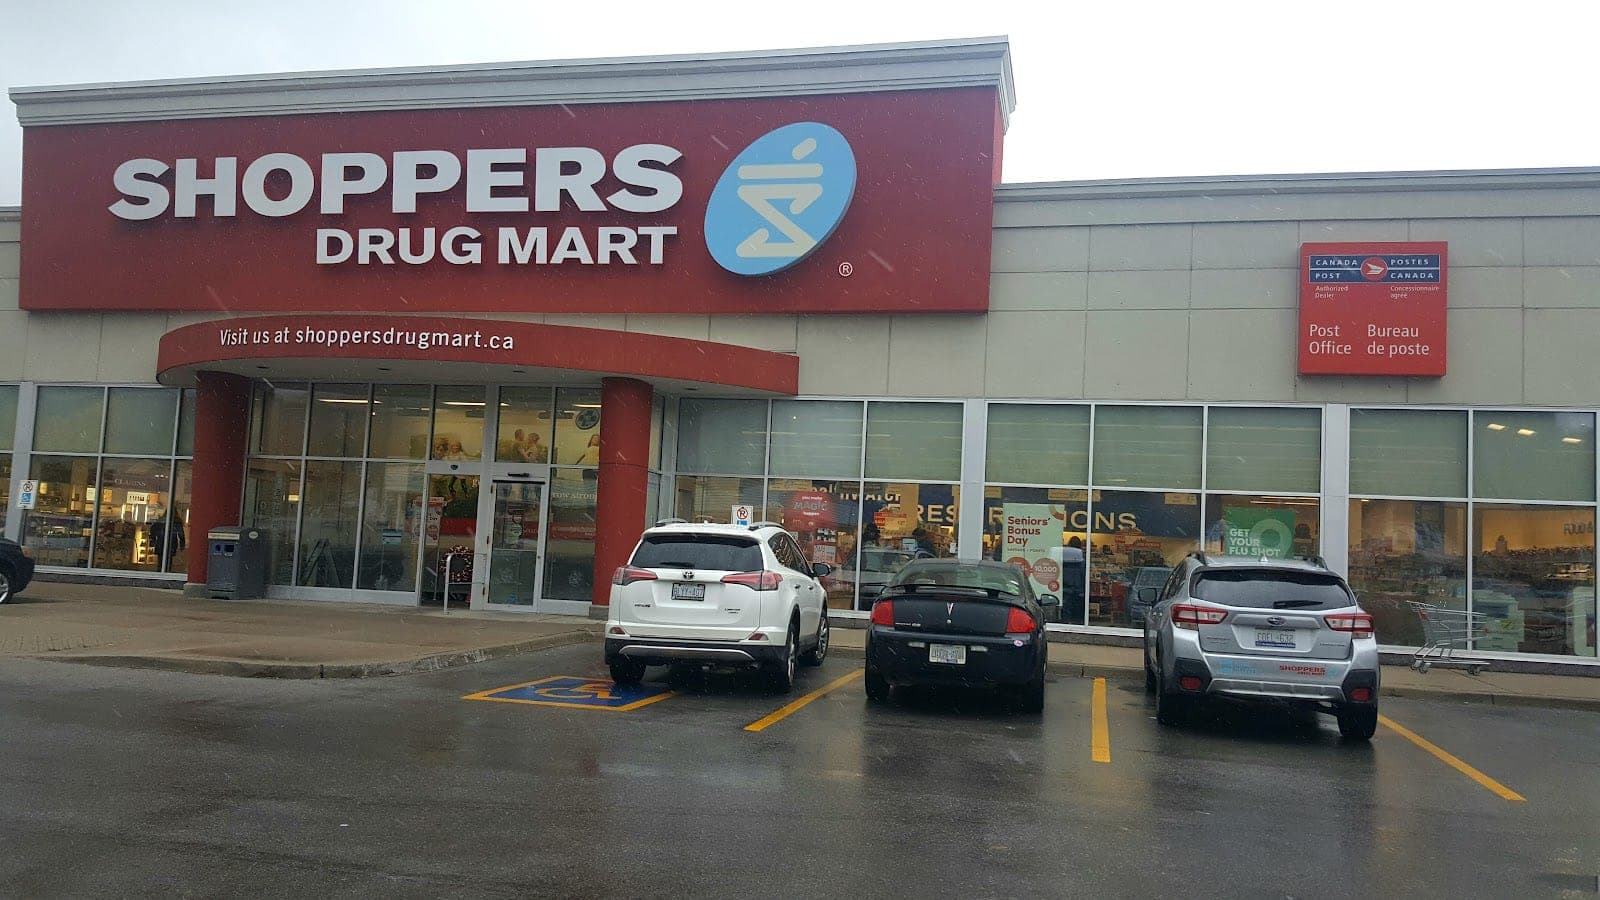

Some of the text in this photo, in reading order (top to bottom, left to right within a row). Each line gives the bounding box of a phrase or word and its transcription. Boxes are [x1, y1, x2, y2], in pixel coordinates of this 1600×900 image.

[107, 143, 684, 221] SHOPPERS
[316, 226, 679, 266] DRUG MART
[1309, 324, 1340, 337] Post
[1367, 324, 1419, 338] Bureau
[220, 325, 514, 350] Visit us at shoppersdrugmart.ca
[1309, 341, 1352, 354] Office
[1367, 341, 1430, 358] de poste
[1007, 515, 1051, 526] Seniors'
[1007, 525, 1041, 536] Bonus
[1229, 528, 1251, 537] GET
[1007, 536, 1029, 547] Day
[1229, 538, 1260, 547] YOUR
[1229, 546, 1280, 557] FLU SHOT
[1279, 665, 1326, 673] SHOPPERS
